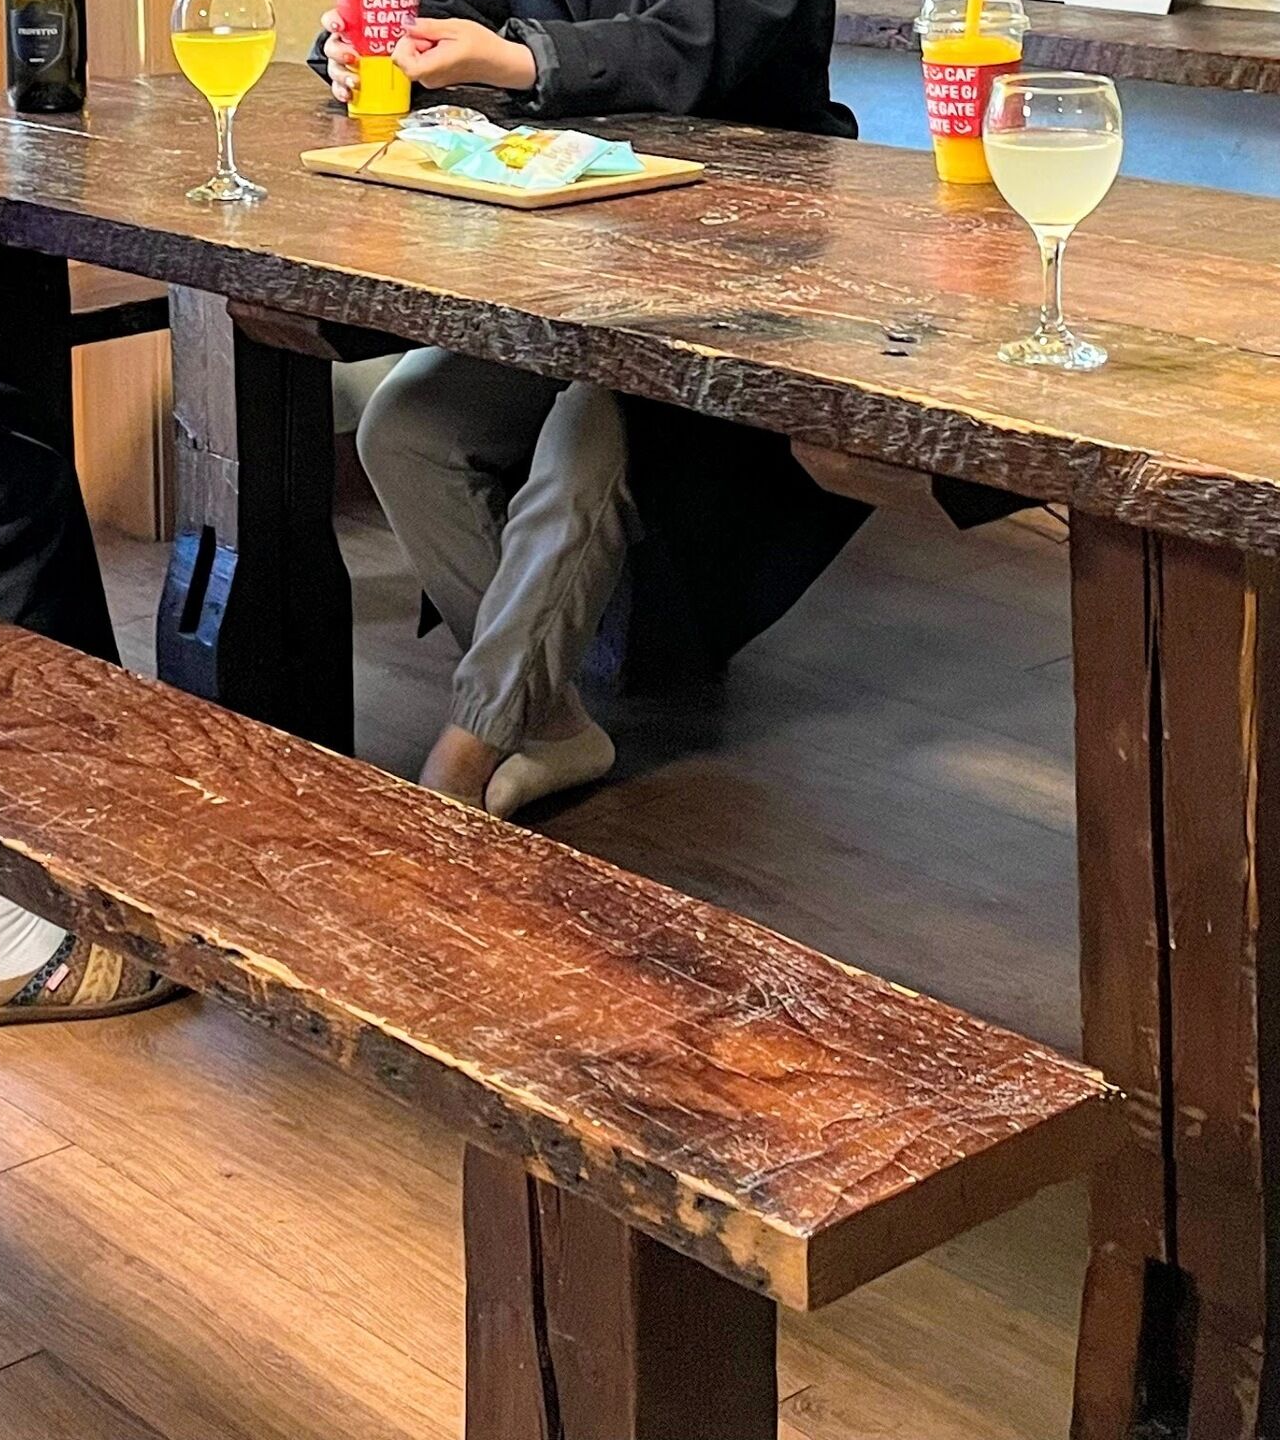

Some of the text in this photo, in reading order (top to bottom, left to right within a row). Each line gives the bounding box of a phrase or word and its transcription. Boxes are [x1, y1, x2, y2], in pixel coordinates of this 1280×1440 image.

[364, 25, 389, 39] ATE
[944, 67, 976, 82] CAF
[940, 102, 976, 117] GATE
